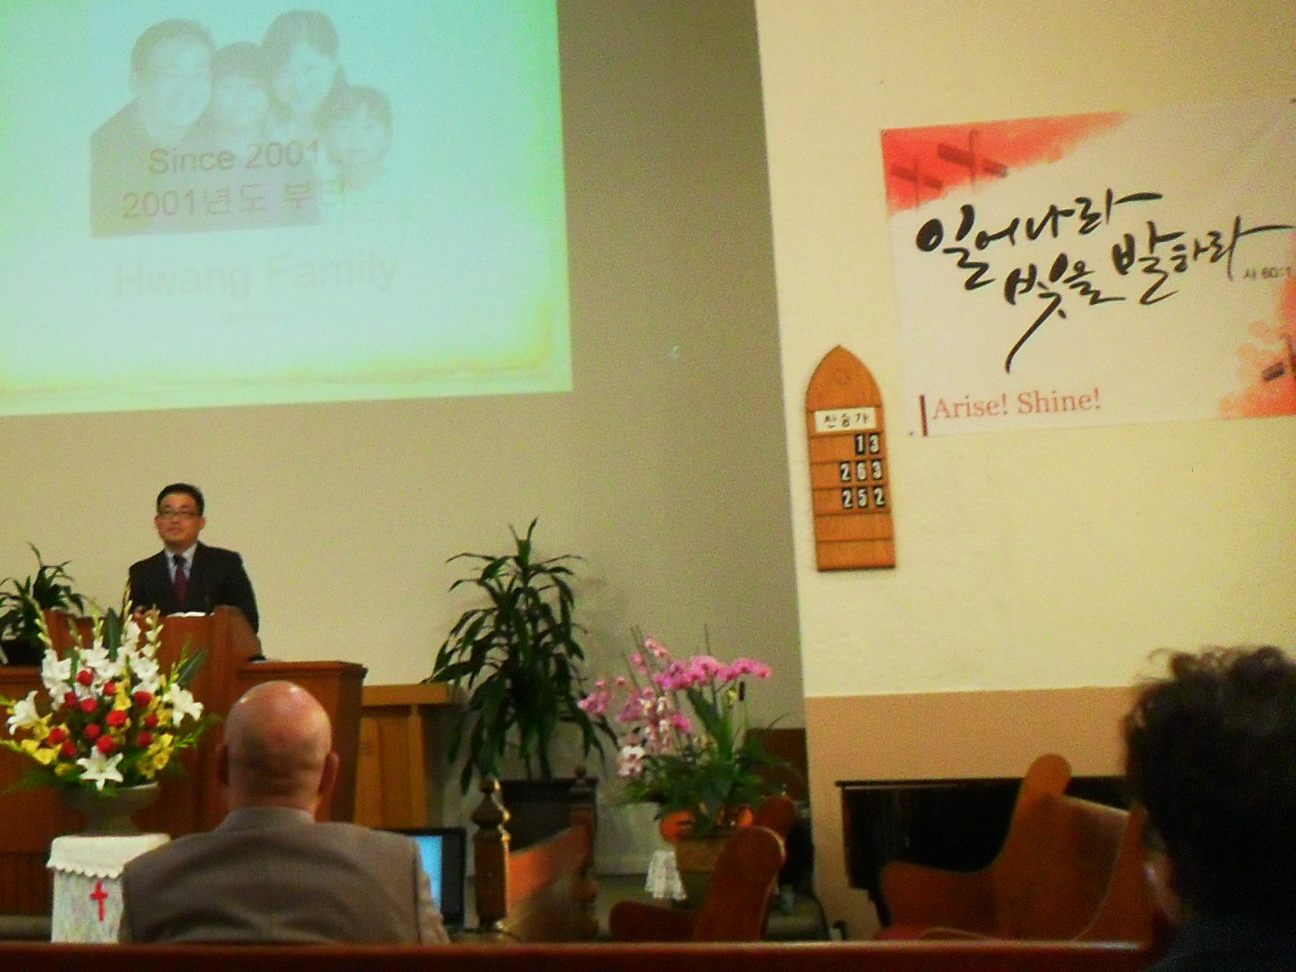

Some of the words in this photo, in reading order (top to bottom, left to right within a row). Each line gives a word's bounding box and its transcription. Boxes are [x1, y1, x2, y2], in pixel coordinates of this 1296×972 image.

[148, 146, 234, 174] Since
[916, 187, 1163, 291] 일어나라
[115, 262, 252, 301] Hwang
[266, 251, 399, 293] Family
[1004, 252, 1126, 373] 빛을
[1112, 215, 1296, 306] 발하라
[932, 393, 1008, 420] Arise!
[1017, 387, 1101, 415] Shine!
[856, 434, 880, 454] 13
[842, 487, 886, 509] 252
